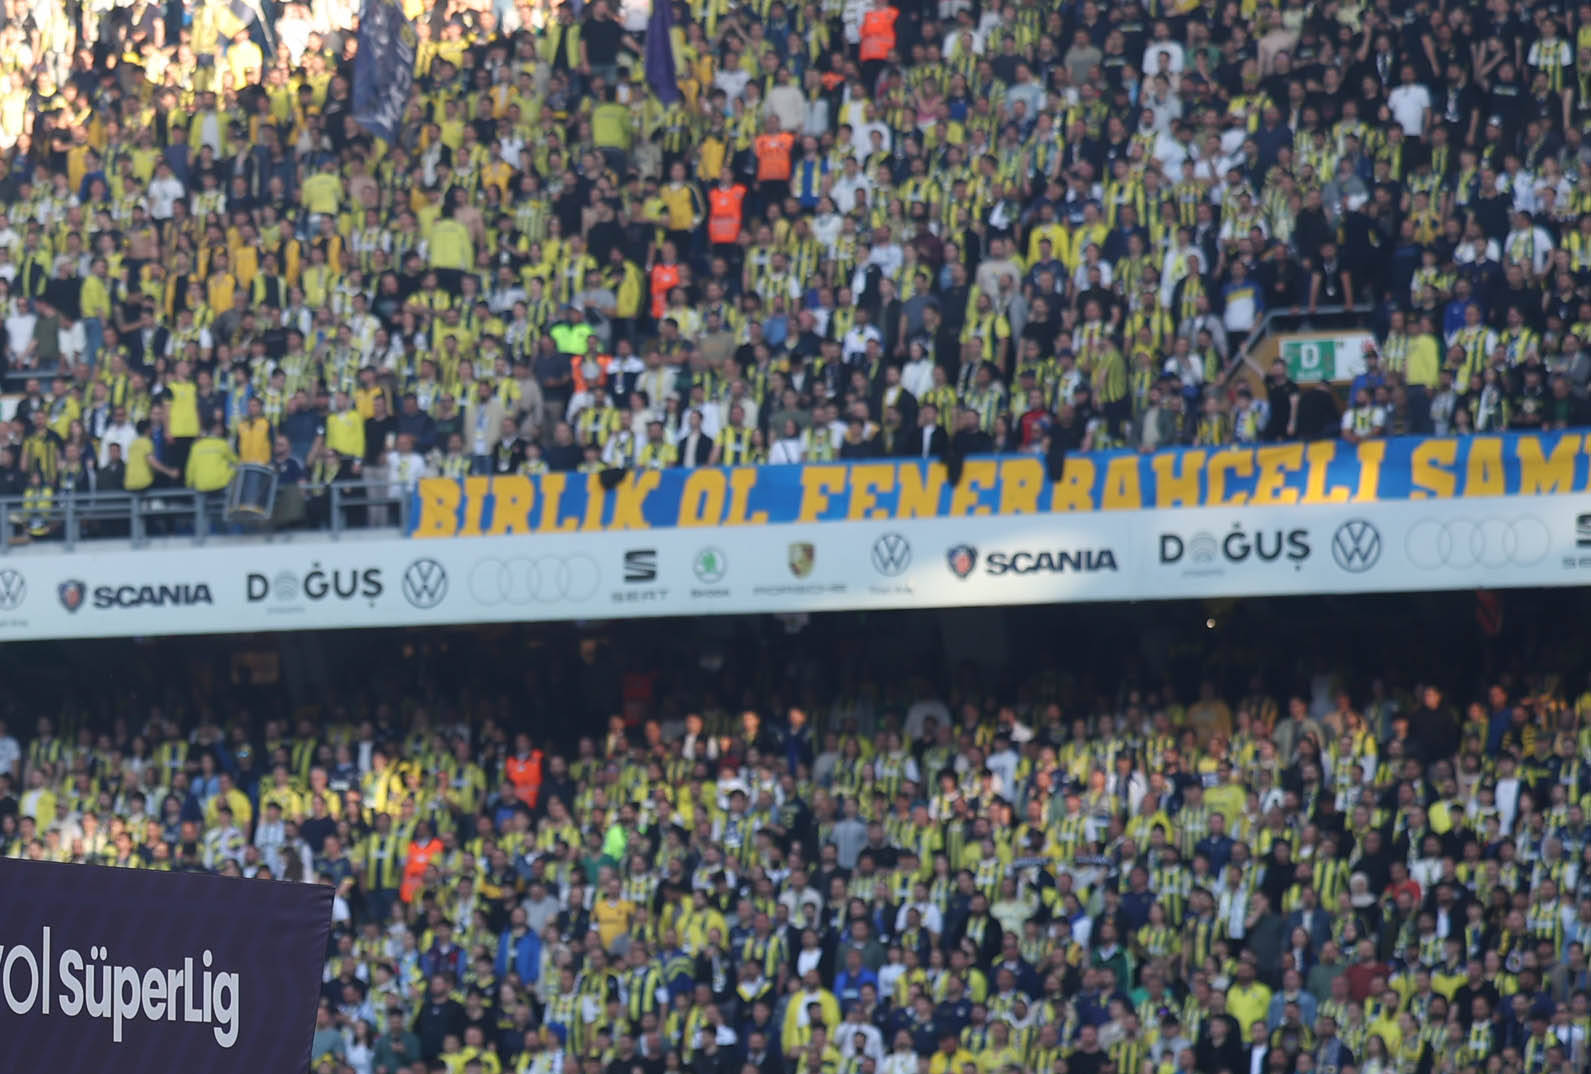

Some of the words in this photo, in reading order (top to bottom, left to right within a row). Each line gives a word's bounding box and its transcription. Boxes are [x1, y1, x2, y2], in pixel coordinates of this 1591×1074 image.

[1299, 341, 1319, 368] D
[677, 467, 769, 527] OL
[1408, 433, 1591, 500] SAM
[986, 549, 1119, 576] SCANIA
[93, 582, 212, 609] SCANIA
[60, 945, 241, 1049] süperLig
